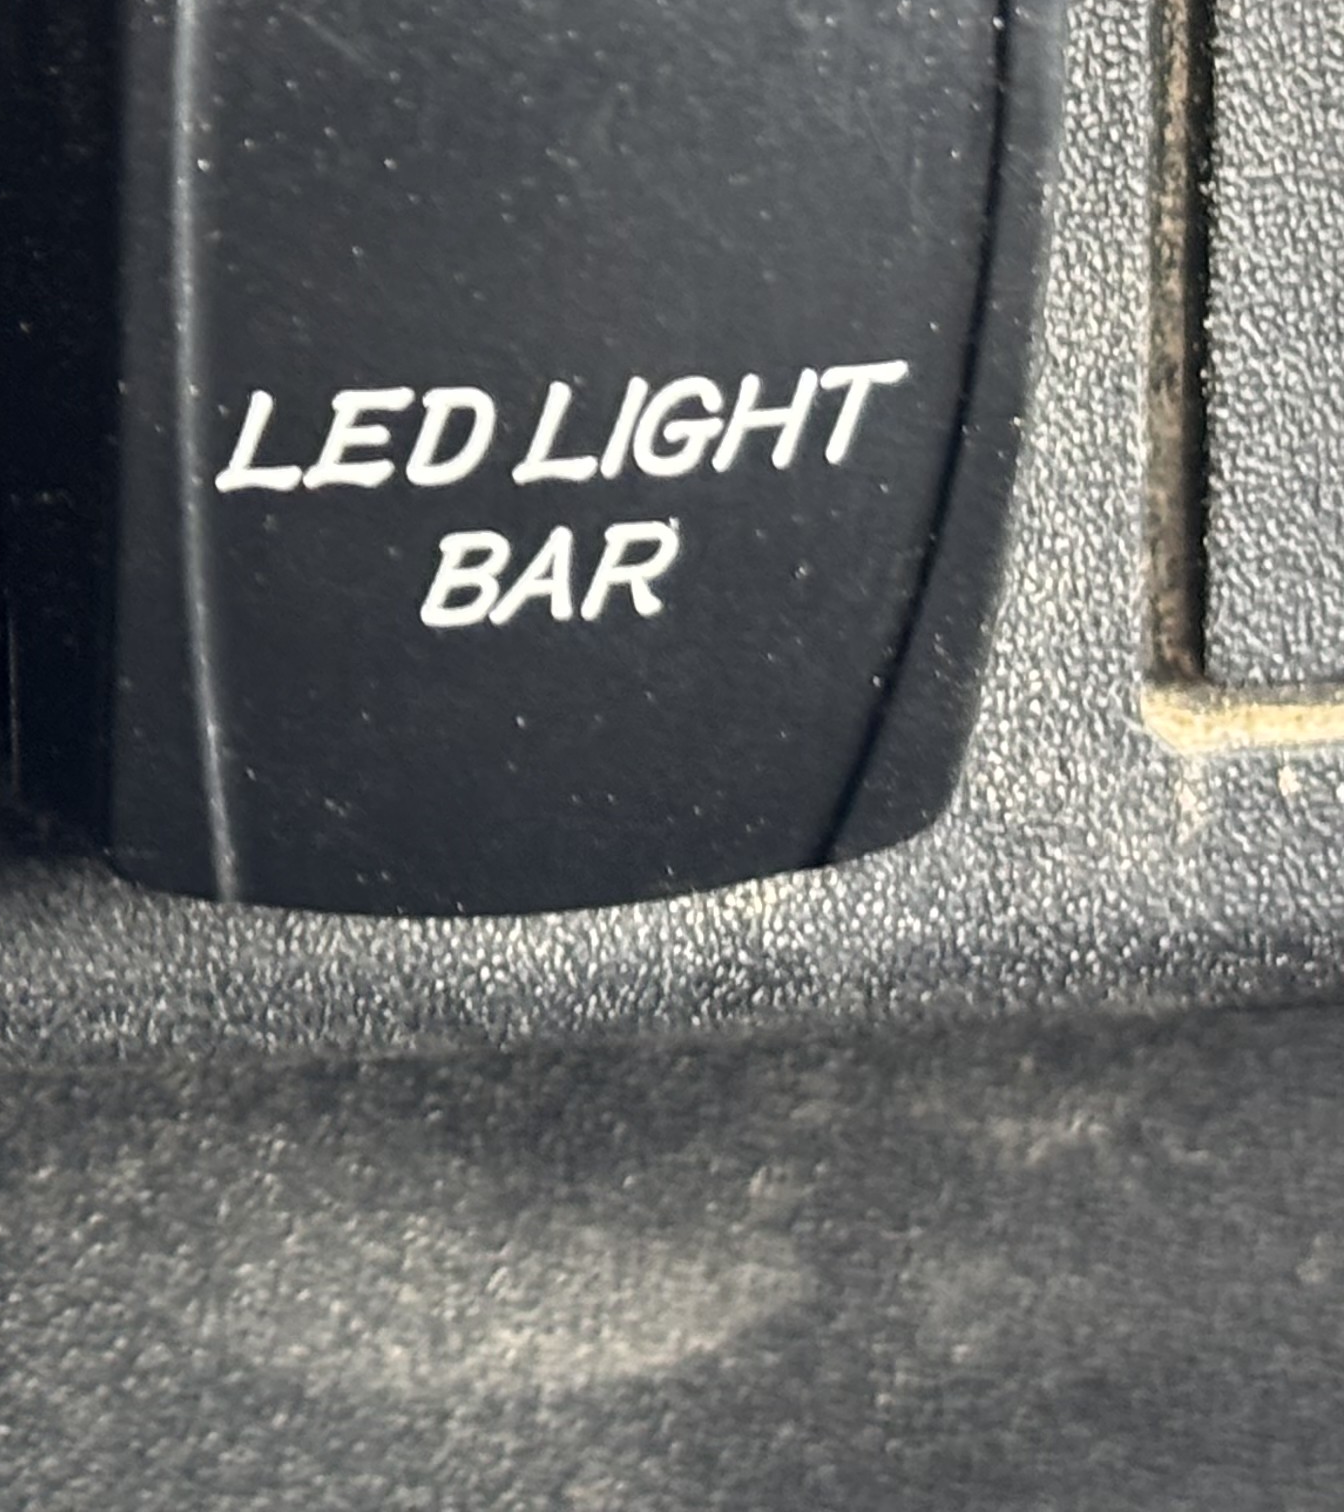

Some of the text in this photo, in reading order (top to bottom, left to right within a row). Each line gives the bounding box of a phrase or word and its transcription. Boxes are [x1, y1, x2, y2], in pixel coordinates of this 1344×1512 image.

[214, 359, 909, 492] LED LIGHT
[420, 517, 680, 628] BAR
